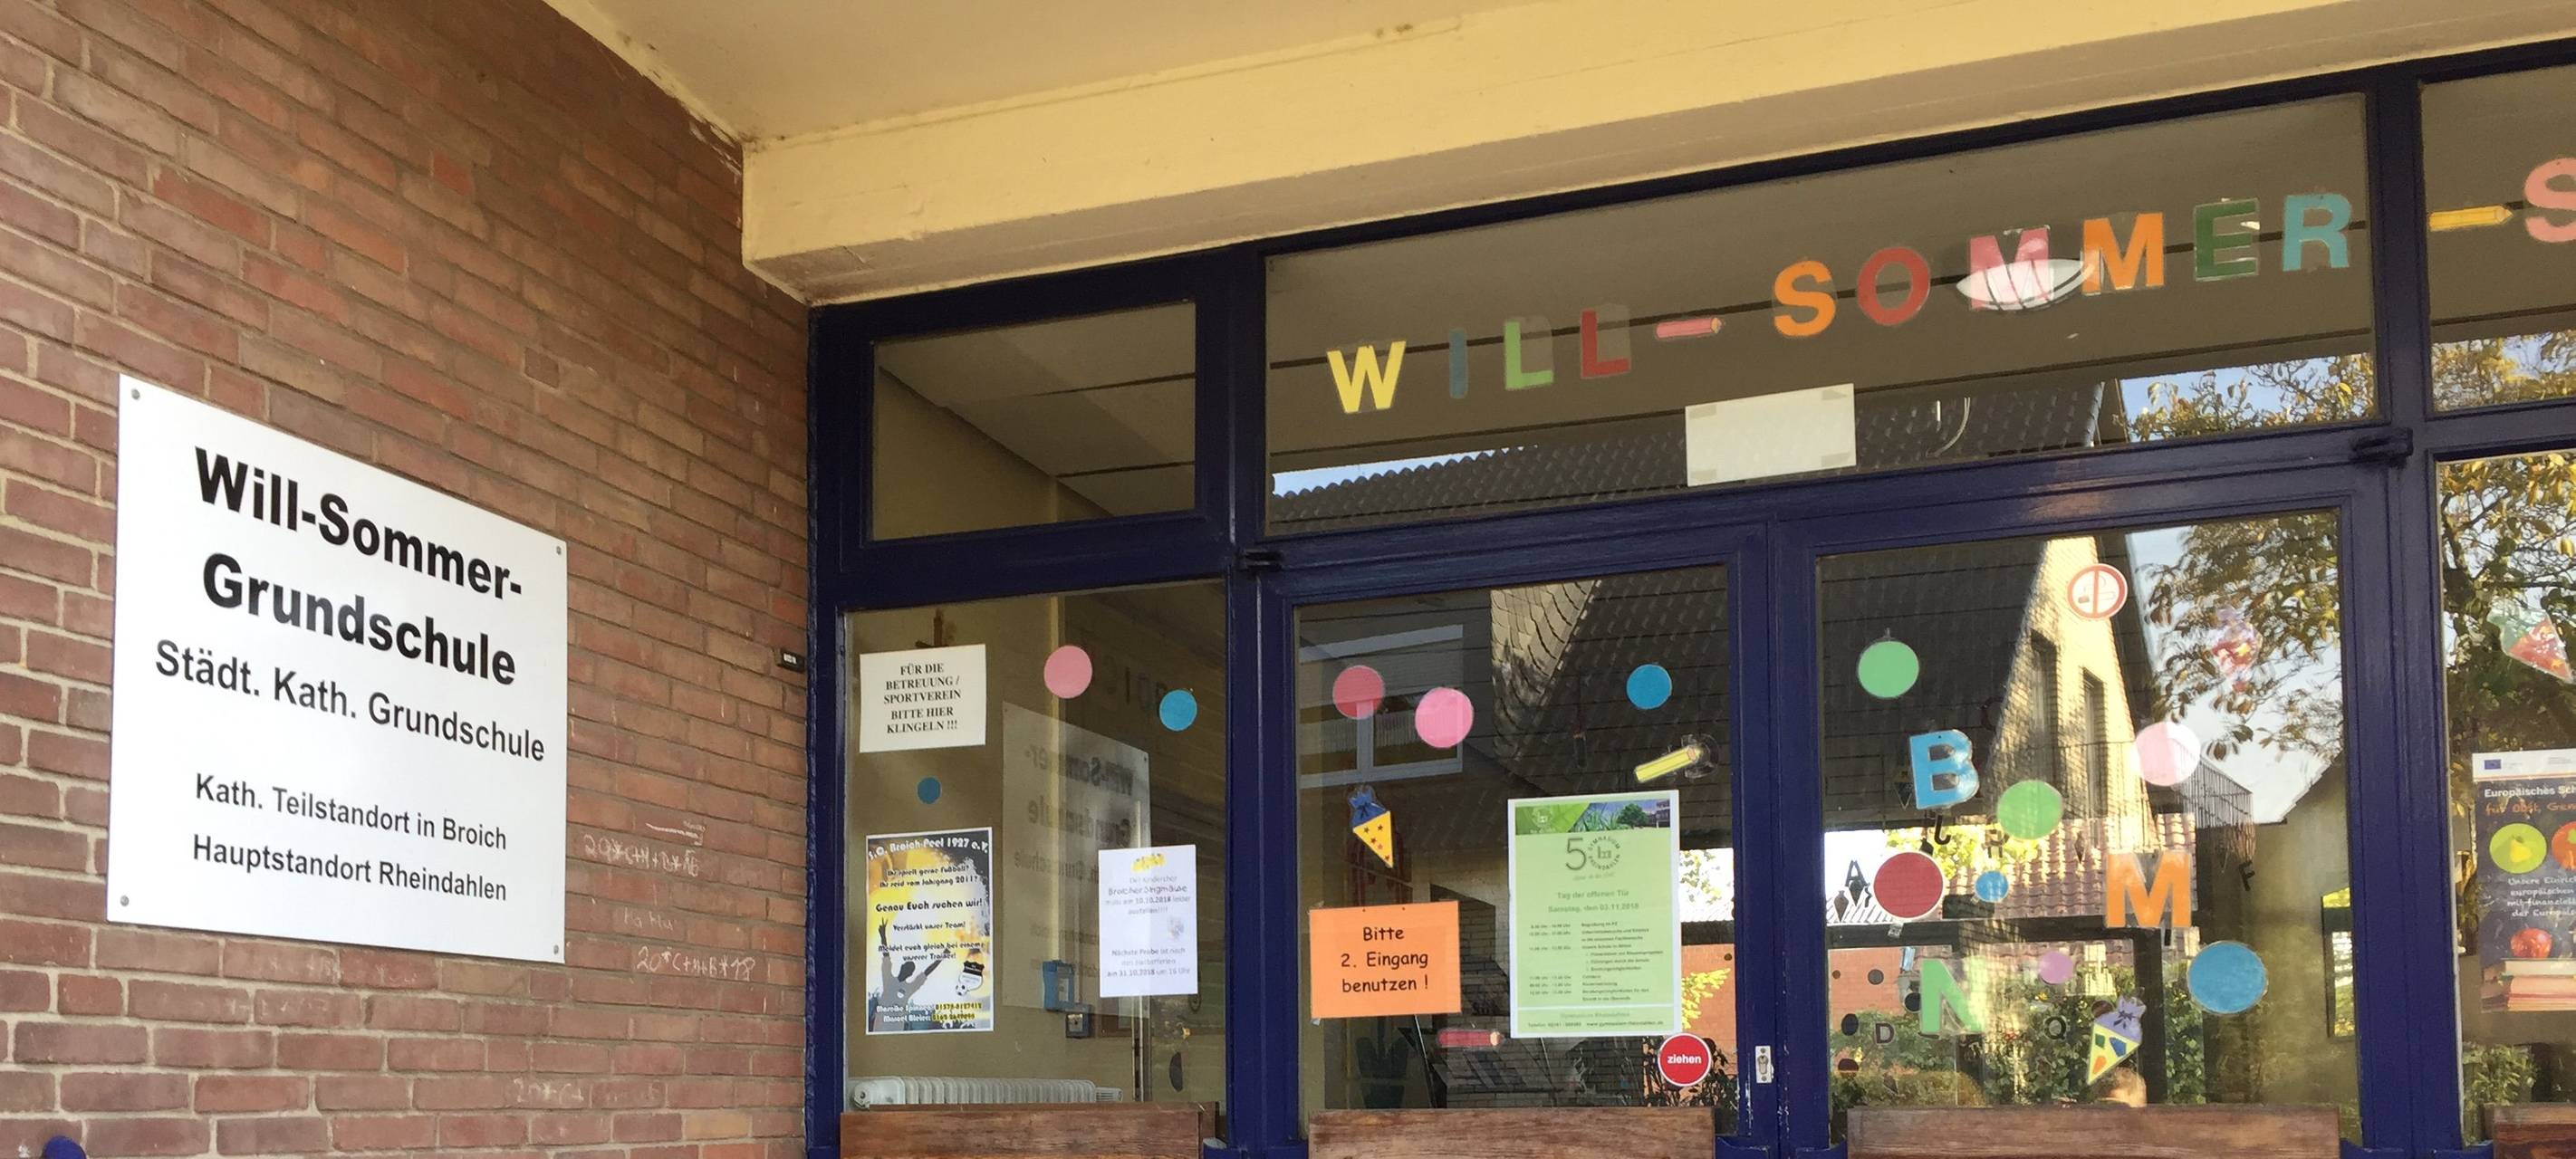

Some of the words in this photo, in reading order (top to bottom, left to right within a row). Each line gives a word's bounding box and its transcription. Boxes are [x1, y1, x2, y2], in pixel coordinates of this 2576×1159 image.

[1327, 309, 1630, 414] WILL
[1773, 193, 2353, 338] SOMMER
[194, 445, 524, 601] Will-Sommer-
[203, 552, 516, 686] Grundschule
[899, 664, 922, 676] FÜR
[925, 663, 945, 675] DIE
[885, 676, 954, 691] BETREUUNG
[155, 638, 261, 697] Städt.
[274, 666, 358, 719] Kath.
[368, 691, 546, 761] Grundschule
[883, 689, 962, 704] SPORTVEREIN
[890, 708, 924, 721] BITTE
[926, 706, 955, 718] HIER
[886, 721, 945, 734] KLINGELN
[2484, 786, 2556, 798] Europäisches
[196, 773, 264, 810] Kath.
[272, 785, 411, 835] Teilstandort
[418, 811, 436, 838] in
[443, 815, 507, 851] Broich
[947, 837, 970, 848] 1927
[193, 834, 373, 884] Hauptstandort
[379, 859, 507, 902] Rheindahlen
[875, 903, 904, 913] Genau
[907, 901, 929, 911] Euch
[931, 899, 964, 909] suchen
[1362, 926, 1405, 942] Bitte
[1341, 953, 1358, 968] 2.
[1366, 951, 1428, 970] Eingang
[1341, 978, 1418, 993] benutzen
[1667, 1053, 1702, 1065] ziehen
